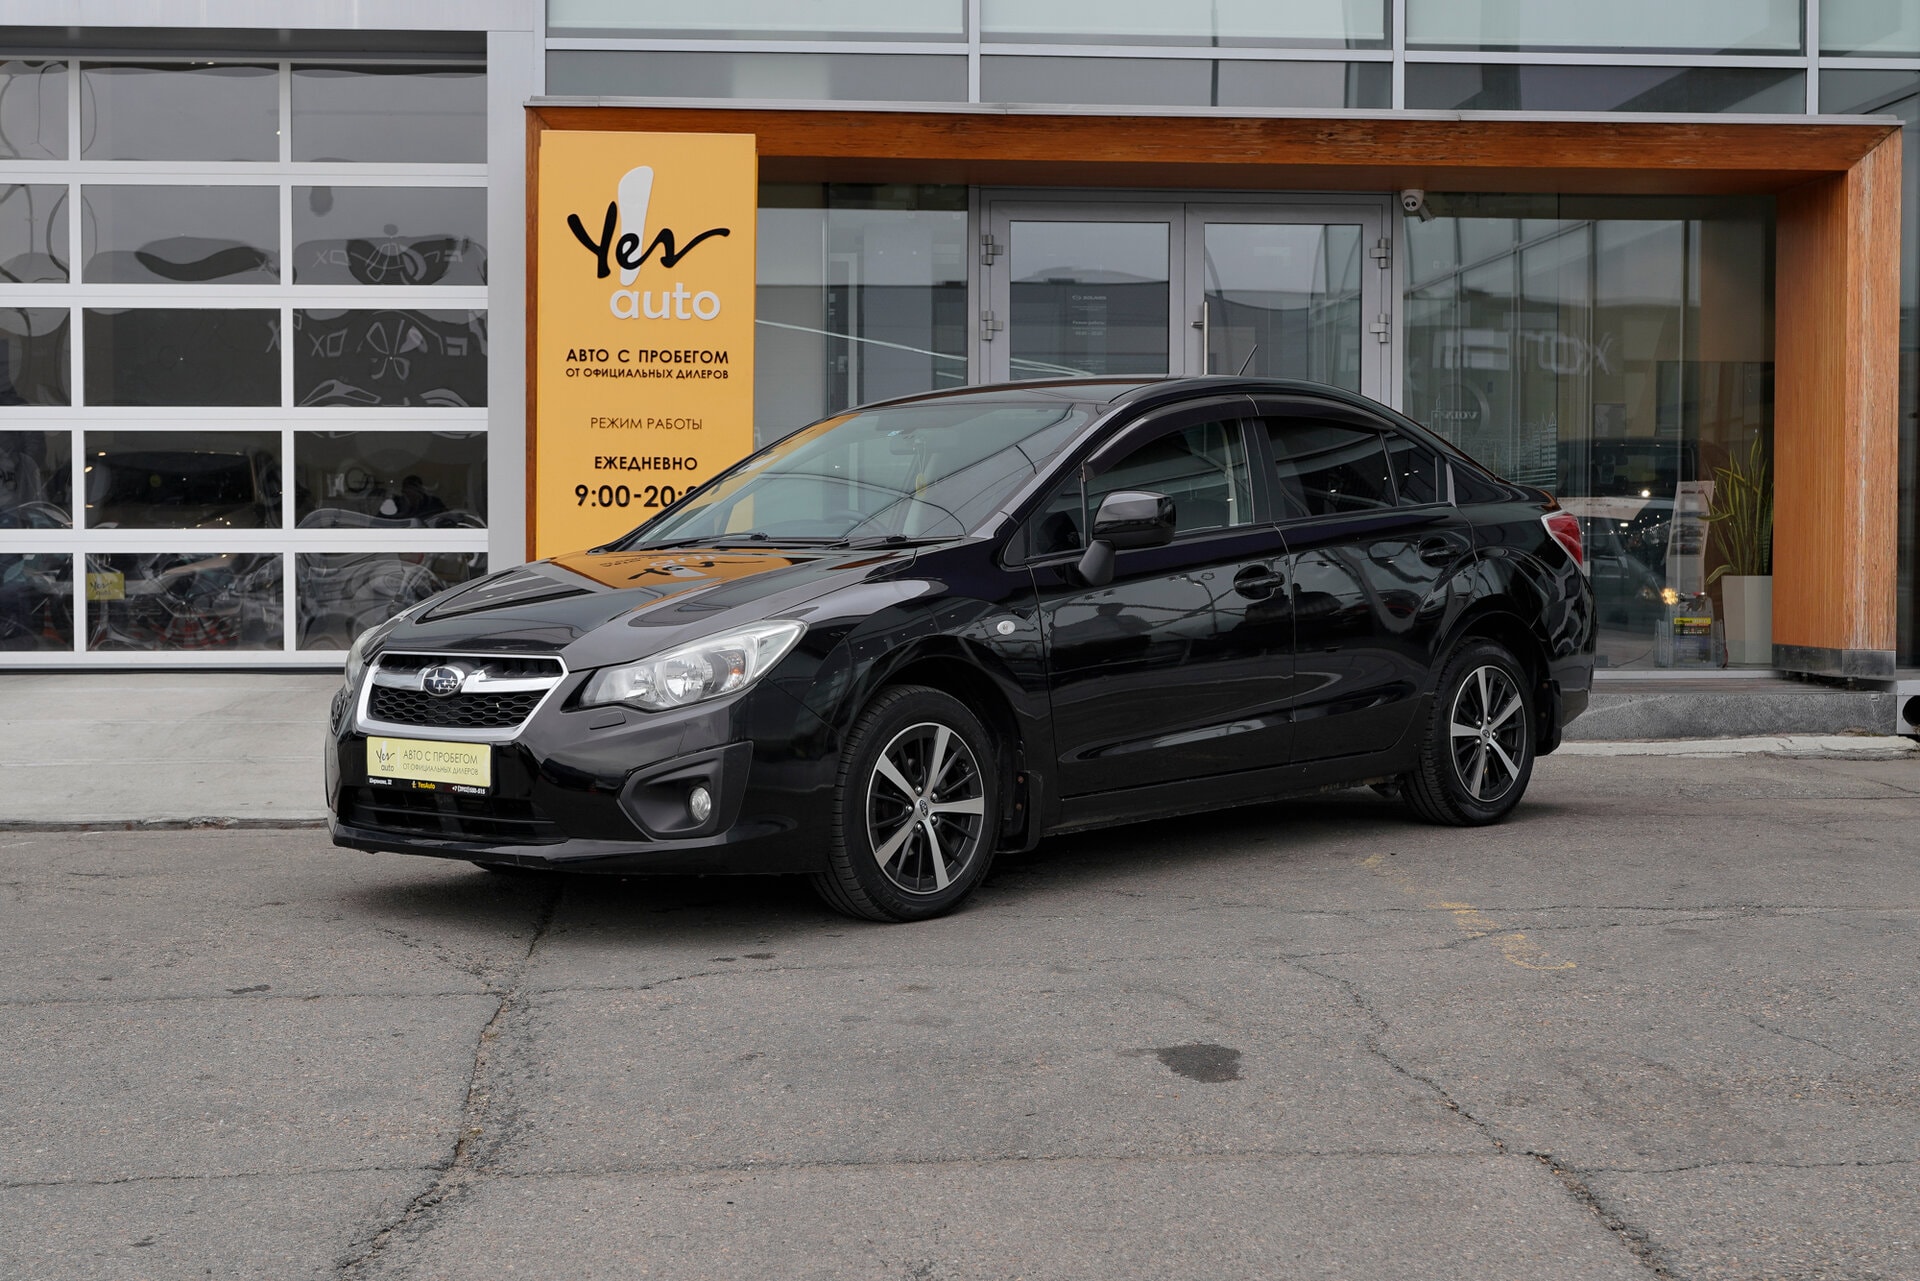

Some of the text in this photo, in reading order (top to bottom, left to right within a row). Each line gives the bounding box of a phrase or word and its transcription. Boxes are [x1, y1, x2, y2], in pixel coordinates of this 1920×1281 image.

[610, 282, 721, 320] auto
[566, 349, 729, 364] АВТО С ПРОБЕГОМ
[566, 368, 729, 380] ОТ ОФИЦИАЛЬНЫХ ДИЛЕРОВ
[590, 417, 703, 430] РЕЖИМ РАБОТЫ
[594, 456, 698, 471] ЕЖЕДНЕВНО
[575, 484, 698, 508] 9:00-20:
[403, 750, 478, 764] АВТО С ПРОБЕГОМ
[381, 763, 395, 772] auto
[411, 764, 452, 774] ОФИЦИАЛЬНЫХ
[452, 767, 479, 776] ДИЛЕРОВ
